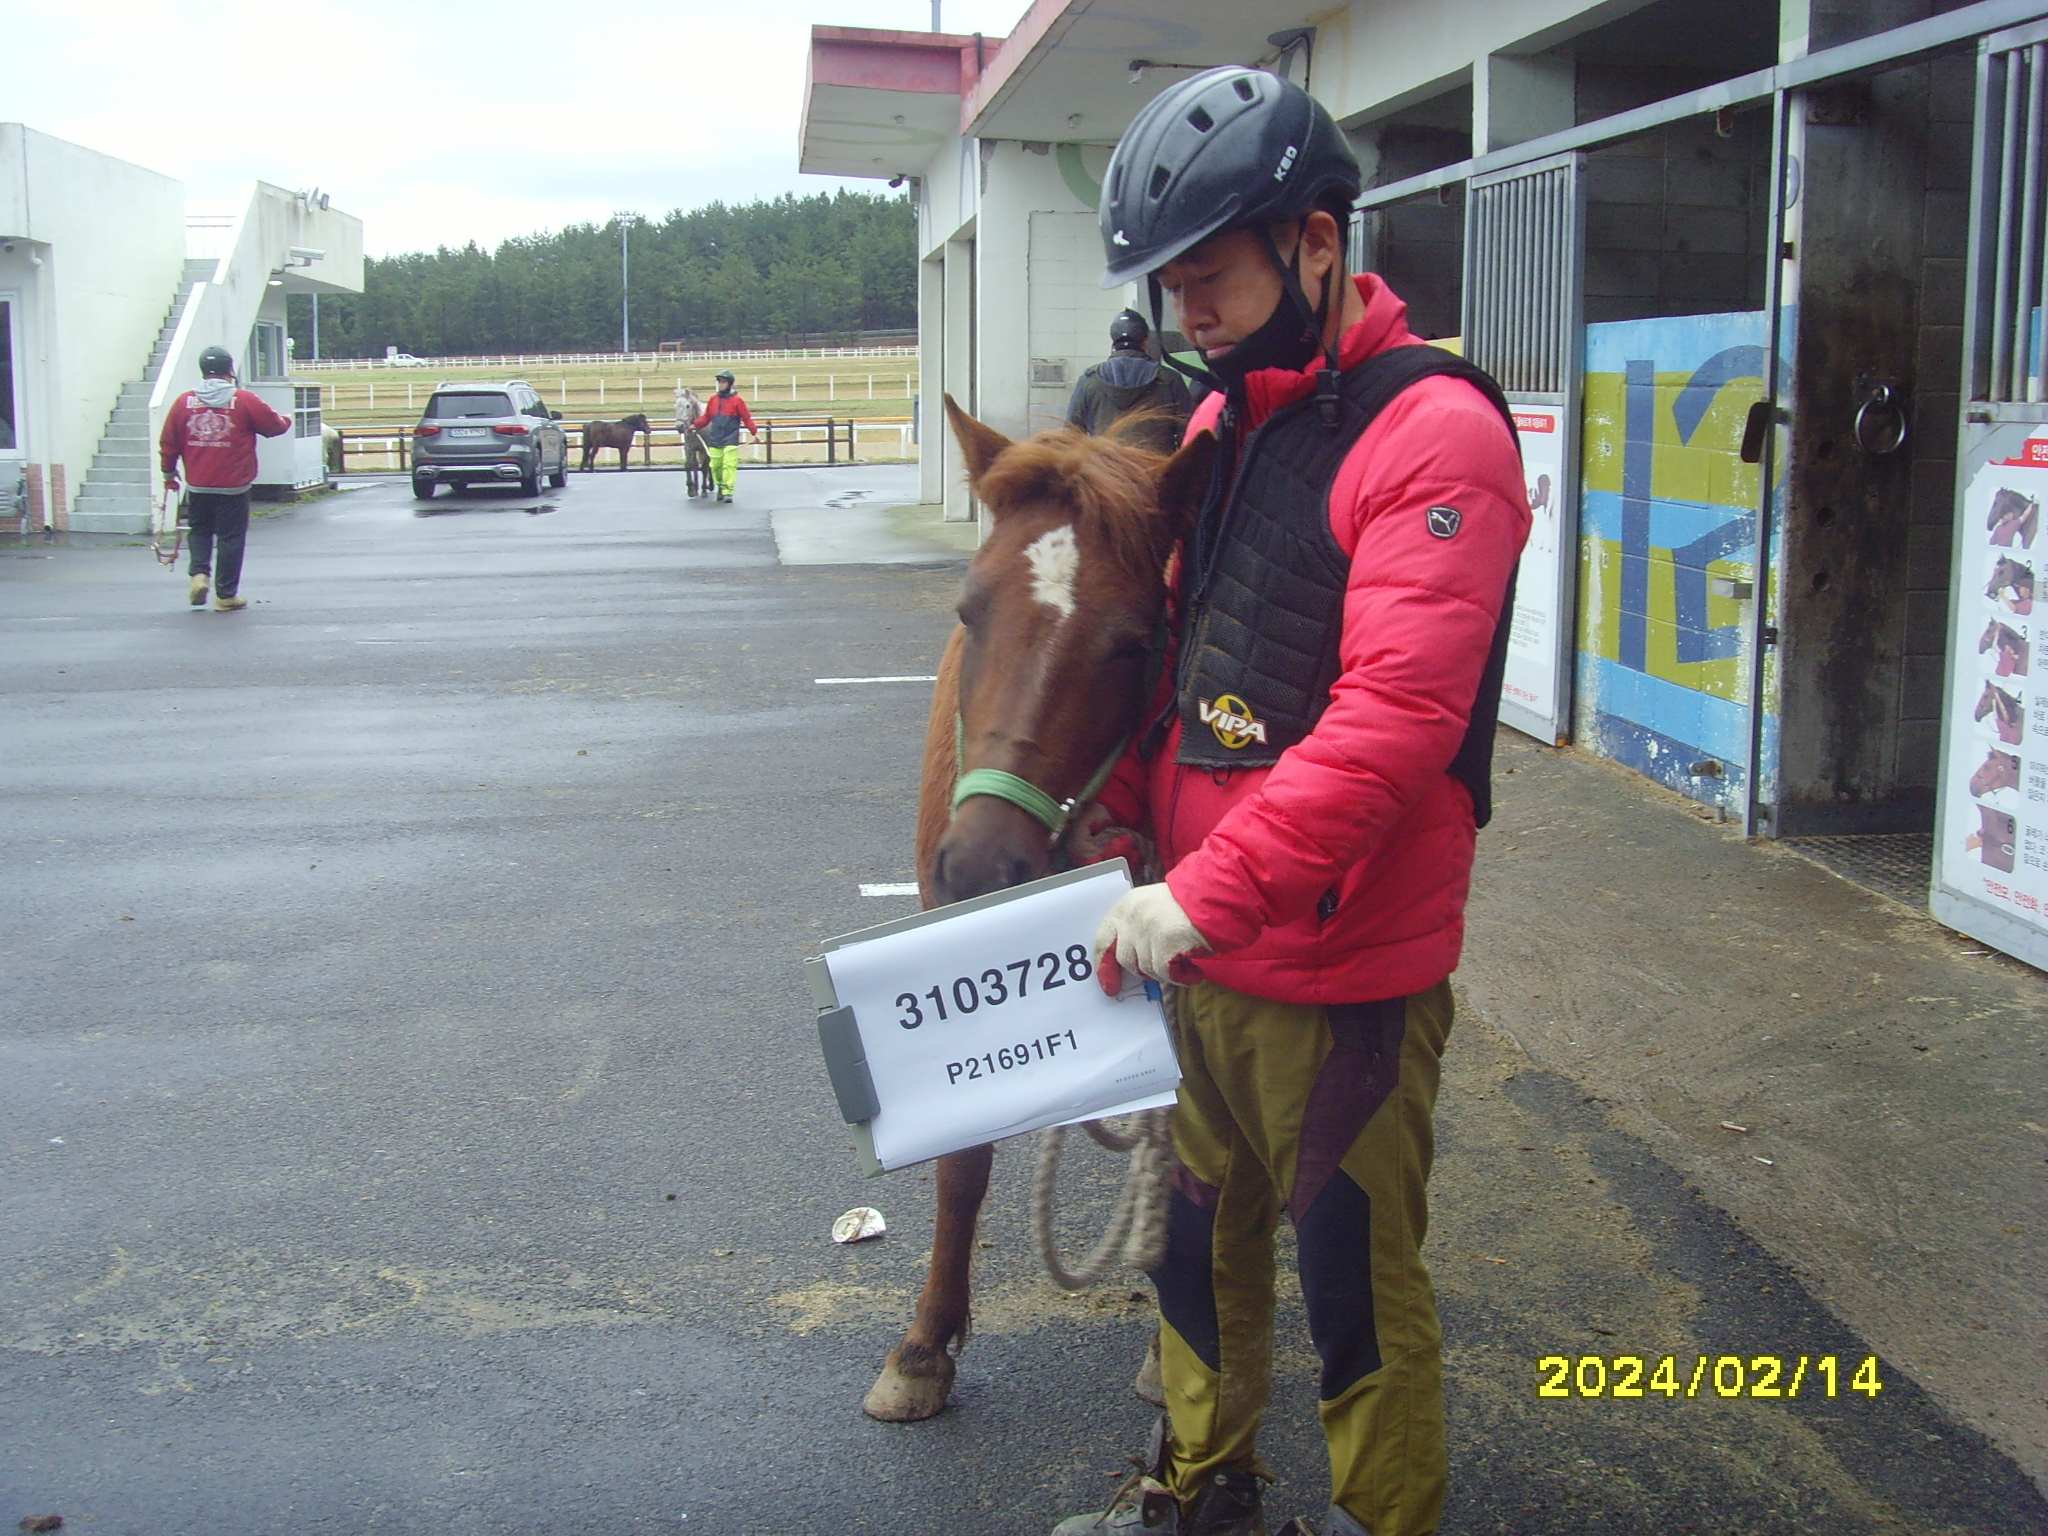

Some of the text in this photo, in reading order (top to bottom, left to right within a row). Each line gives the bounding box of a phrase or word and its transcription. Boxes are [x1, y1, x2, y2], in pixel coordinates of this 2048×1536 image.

[2020, 624, 2028, 640] 3
[1197, 697, 1269, 745] VIPA
[2007, 818, 2014, 834] 6
[895, 944, 1093, 1030] 3103728
[946, 1029, 1078, 1085] P21691F1
